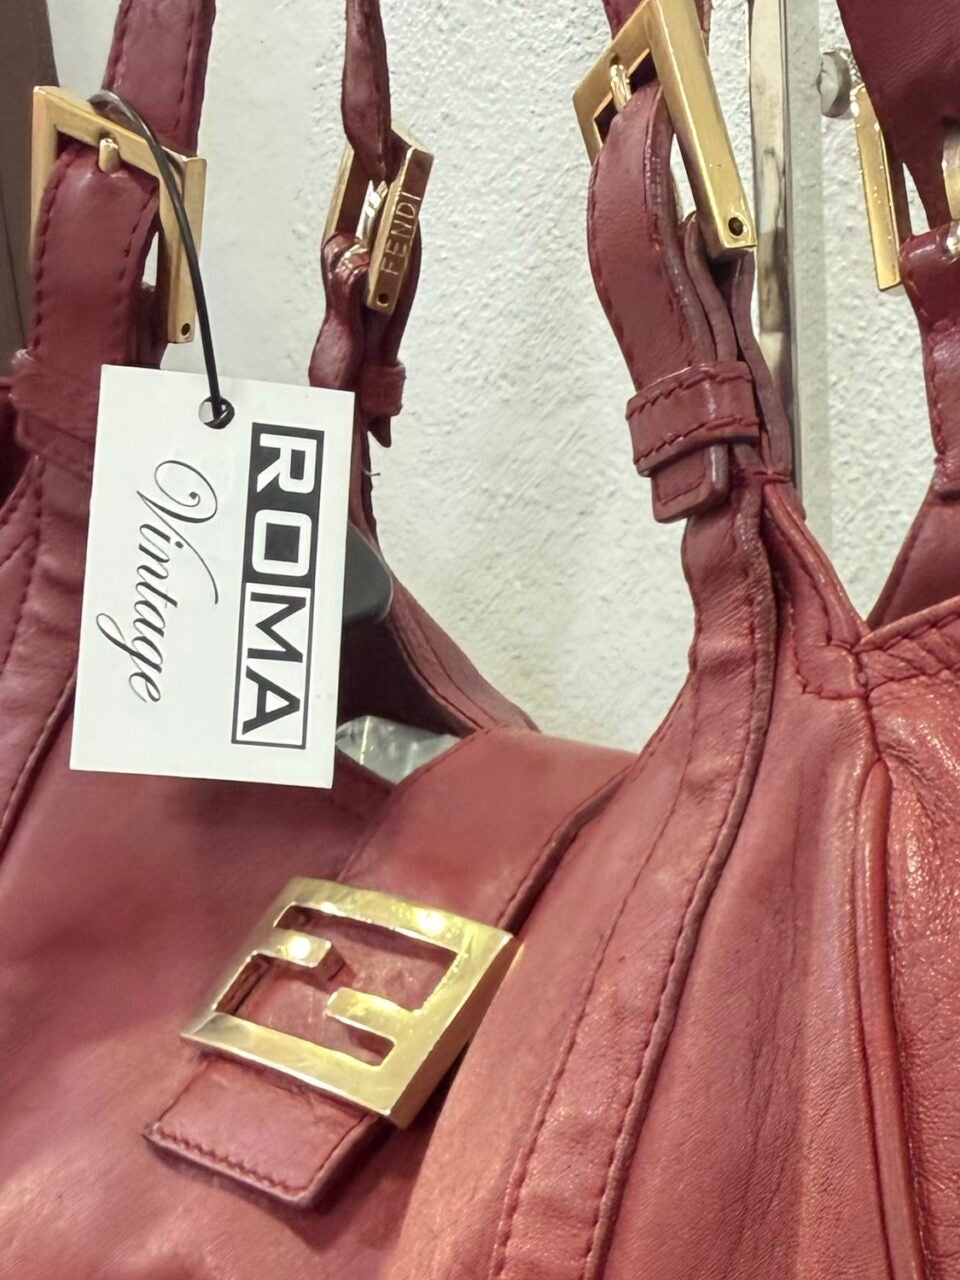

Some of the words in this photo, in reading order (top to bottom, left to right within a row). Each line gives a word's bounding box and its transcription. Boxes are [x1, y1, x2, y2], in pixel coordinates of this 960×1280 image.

[380, 191, 421, 275] FENDI
[96, 459, 219, 704] Vintage
[241, 432, 318, 735] ROMA
